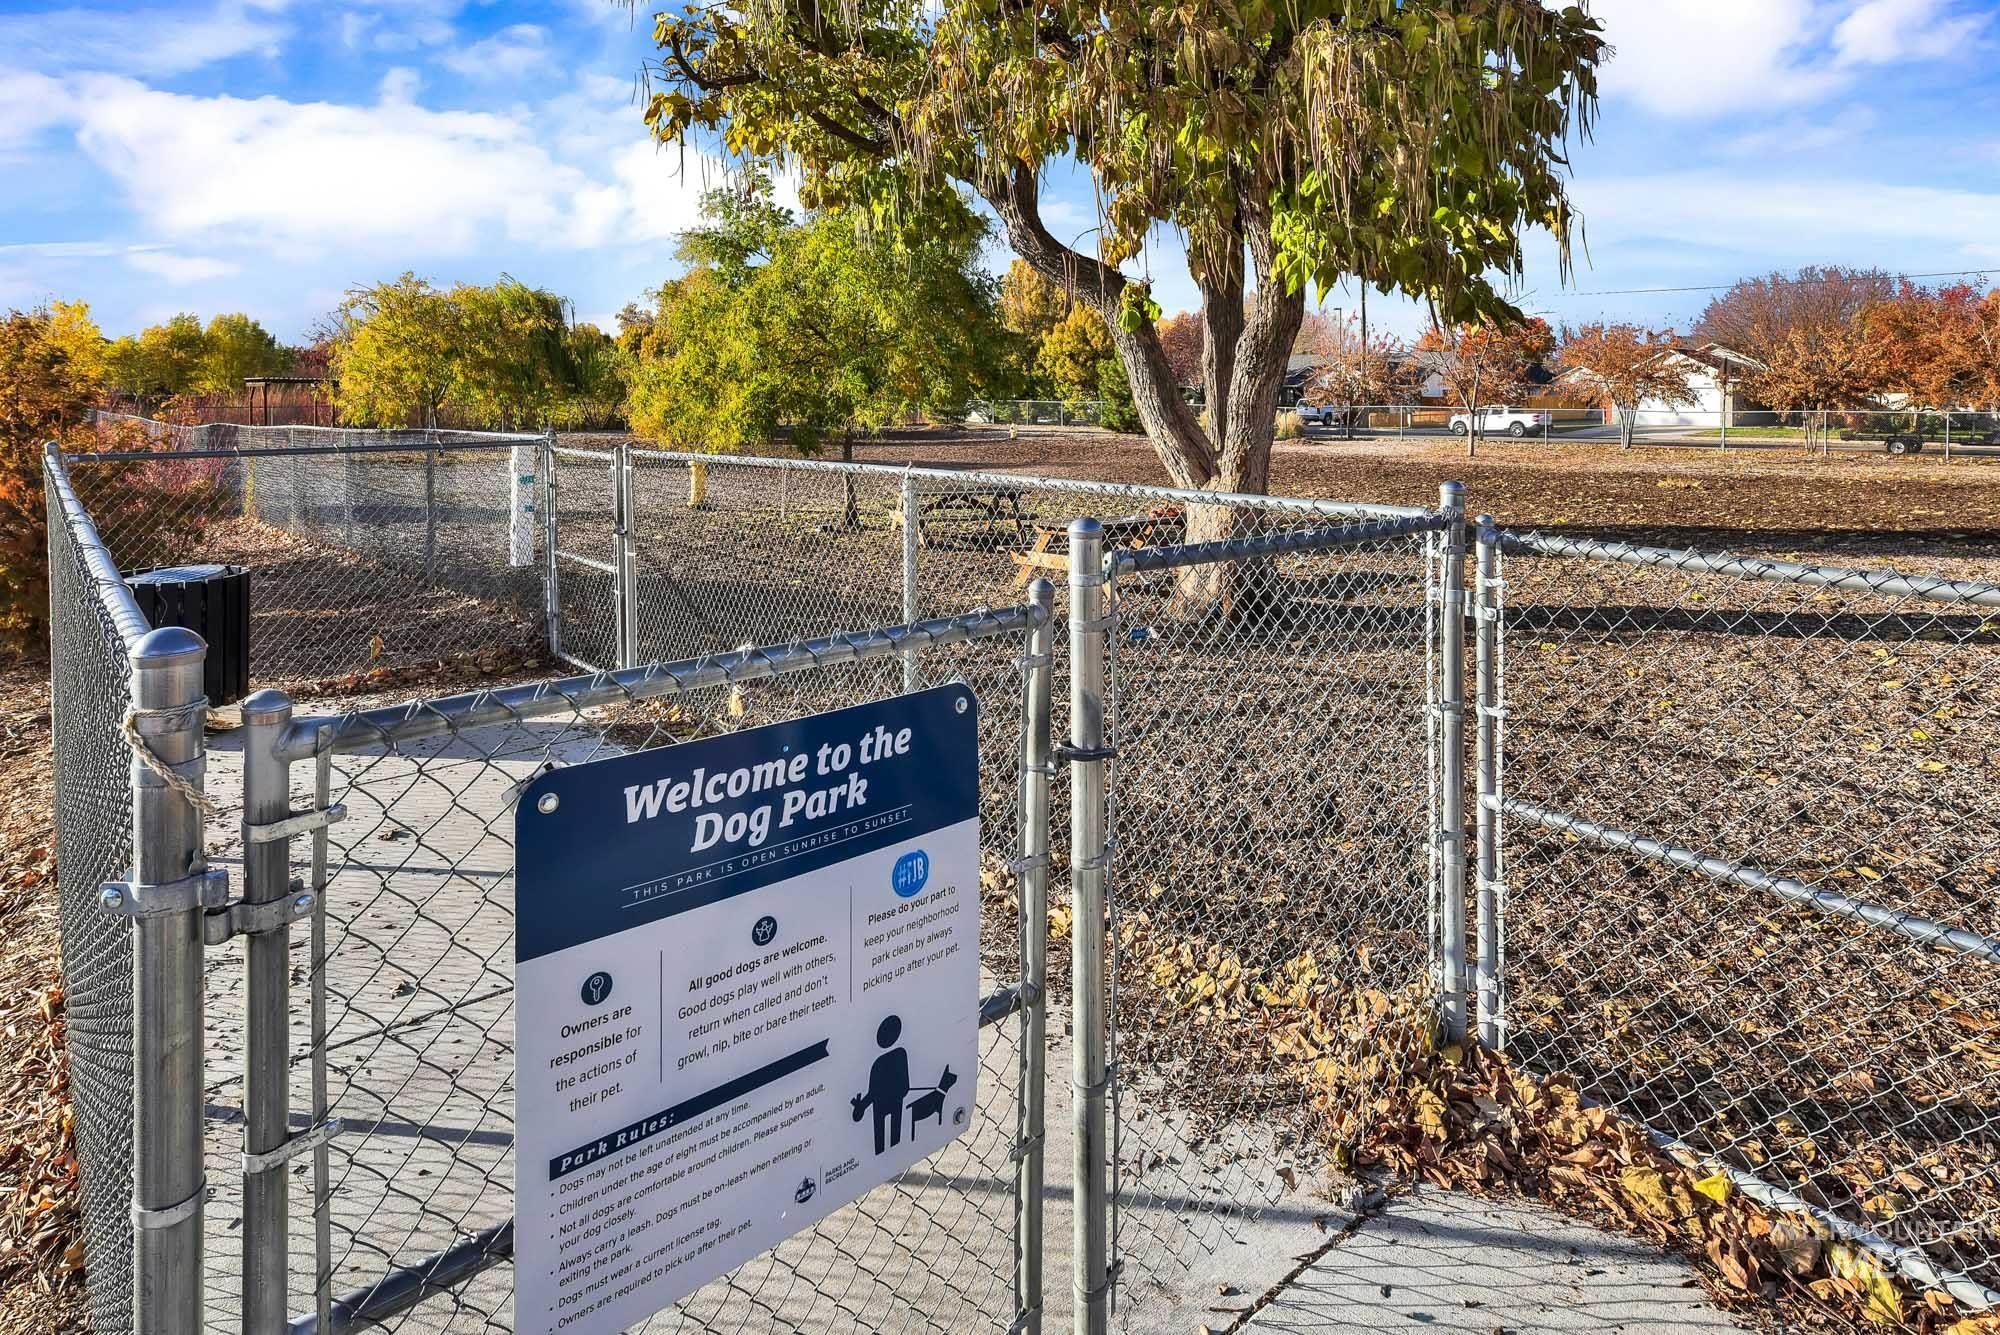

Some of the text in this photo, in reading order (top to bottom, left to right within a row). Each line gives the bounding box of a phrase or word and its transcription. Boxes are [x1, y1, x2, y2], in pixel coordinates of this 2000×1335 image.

[624, 725, 912, 824] Welcome to the
[690, 773, 868, 853] Dog Park
[633, 810, 908, 899] THIS PARK IS OPEN SUNRISE TO SUNSET
[864, 903, 960, 948] keep your neighborhood
[868, 886, 956, 925] Please do your part to
[688, 935, 828, 992] All good dogs are welcome.
[863, 943, 960, 992] picking up after your pet.
[871, 926, 953, 968] park clean by always
[678, 1002, 707, 1020] Good
[709, 992, 735, 1009] dogs
[737, 981, 758, 1000] play
[760, 973, 781, 990] well
[783, 964, 803, 981] with
[688, 975, 828, 1040] return when called and don't
[550, 1025, 642, 1068] responsible for
[561, 1005, 632, 1039] Owners are
[733, 1026, 751, 1045] bite
[753, 1023, 764, 1036] or
[766, 1014, 787, 1032] bare
[789, 1004, 810, 1022] their
[555, 1050, 638, 1092] the actions of
[570, 1082, 623, 1112] their pet.
[559, 1101, 751, 1194] Dogs may not be left unattended at any time.
[559, 1191, 599, 1215] Children
[601, 1177, 628, 1196] under
[630, 1169, 645, 1182] the
[646, 1162, 663, 1175] age
[665, 1153, 675, 1166] of
[676, 1144, 697, 1161] eight
[699, 1134, 719, 1150] must
[720, 1128, 731, 1140] be
[732, 1104, 783, 1134] accompanied
[784, 1098, 794, 1111] by
[795, 1092, 805, 1104] an
[560, 1113, 675, 1172] Park Rules:
[825, 1158, 855, 1178] PARKS AND
[559, 1106, 815, 1237] Not all dogs are comfortable around children. Please supervise
[825, 1160, 860, 1184] RECREATION
[558, 1138, 813, 1273] Always carry a leash. Dogs must be on-leash when entering or
[559, 1208, 637, 1254] your dog closely.
[558, 1217, 722, 1308] Dogs must wear a current license tag.
[558, 1219, 753, 1328] Owners are required to pick up after their pet.
[559, 1244, 633, 1287] exiting the park.
